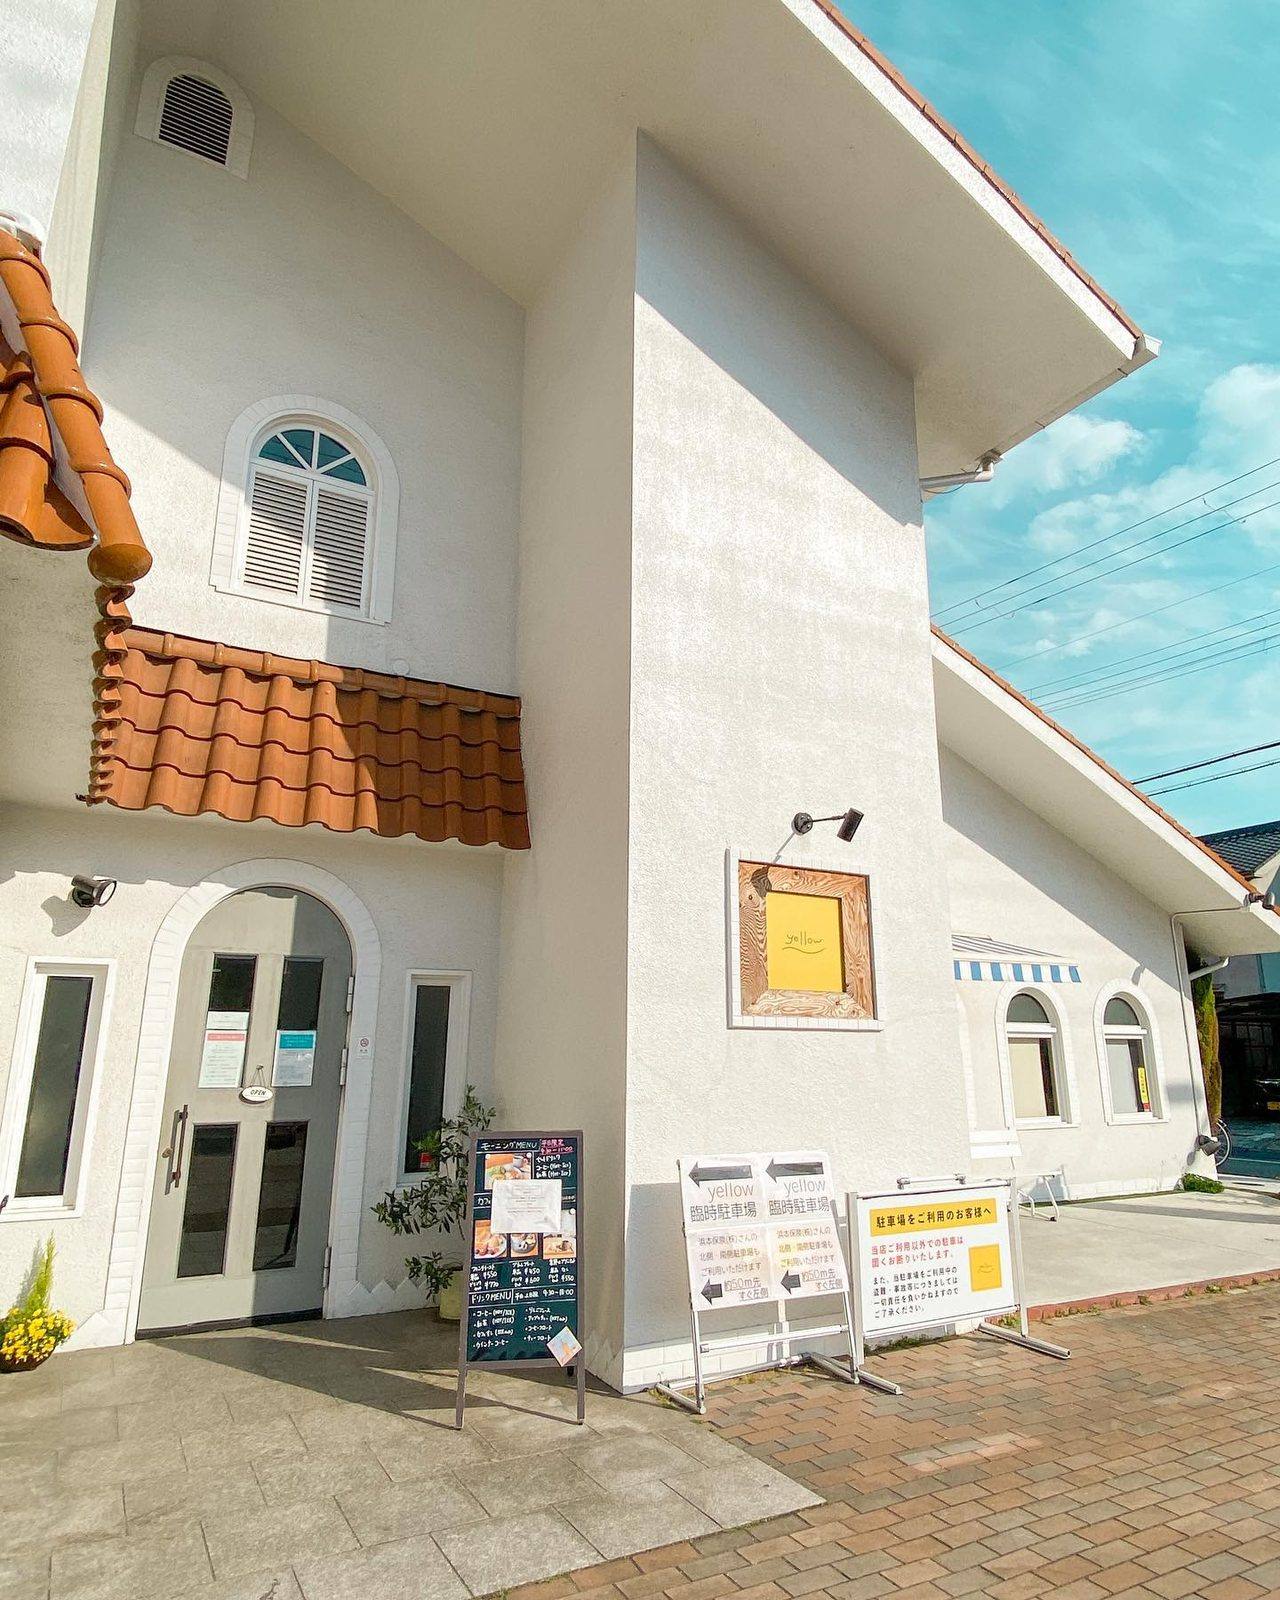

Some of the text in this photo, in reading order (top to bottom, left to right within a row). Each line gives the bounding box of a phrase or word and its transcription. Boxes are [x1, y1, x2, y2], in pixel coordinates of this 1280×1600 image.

[786, 931, 824, 945] yellow
[707, 1182, 754, 1203] yellow
[784, 1179, 826, 1199] yellow
[690, 1201, 757, 1223] 臨時駐車場
[769, 1196, 831, 1216] 臨時駐車場
[876, 1206, 992, 1229] 駐車場をご利用のお客様へ
[471, 1291, 512, 1304] ドリンクMENU
